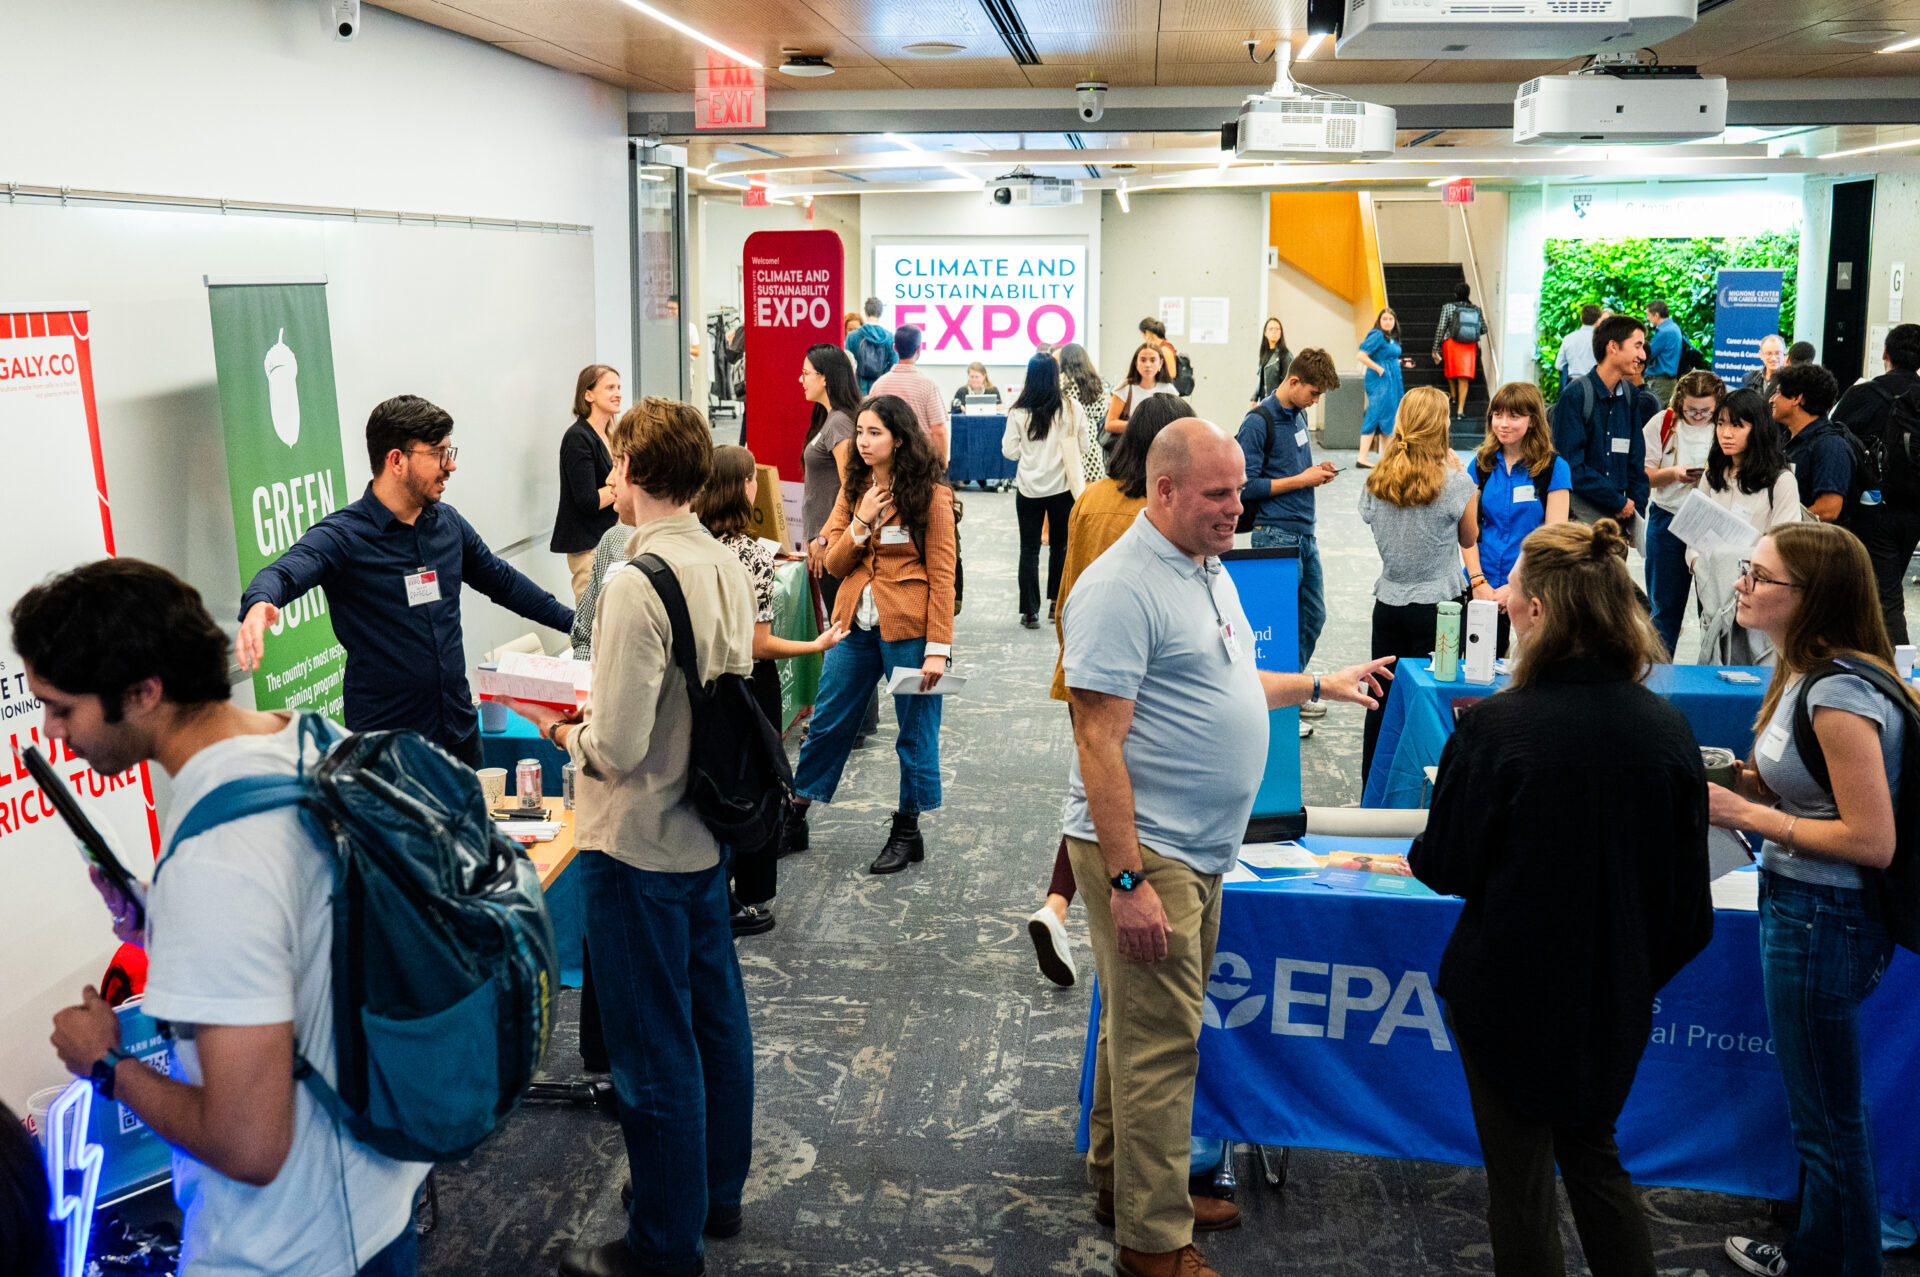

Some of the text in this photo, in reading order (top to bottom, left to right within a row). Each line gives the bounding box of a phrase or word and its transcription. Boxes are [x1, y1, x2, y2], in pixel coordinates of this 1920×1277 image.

[709, 90, 755, 123] EXIT
[747, 191, 767, 205] EXI
[1448, 186, 1472, 201] EXIT
[752, 256, 779, 265] Welcome!
[895, 258, 1076, 277] CLIMATE AND
[757, 269, 830, 282] CLIMATE AND
[1893, 269, 1902, 292] G
[757, 284, 830, 296] SUSTAINABILITY
[895, 283, 1075, 299] SUSTAINABILITY
[757, 297, 831, 329] EXPO
[895, 303, 1076, 351] EXPO
[0, 354, 74, 380] GALY.CO
[253, 469, 335, 557] GREEN
[1254, 625, 1272, 641] nd
[265, 643, 345, 692] The country's most respe
[285, 686, 313, 711] training
[313, 671, 340, 702] program
[1, 697, 42, 721] IONING
[0, 765, 137, 838] RICUTURE
[1271, 957, 1453, 1052] EPA
[1688, 1024, 1776, 1055] Protec
